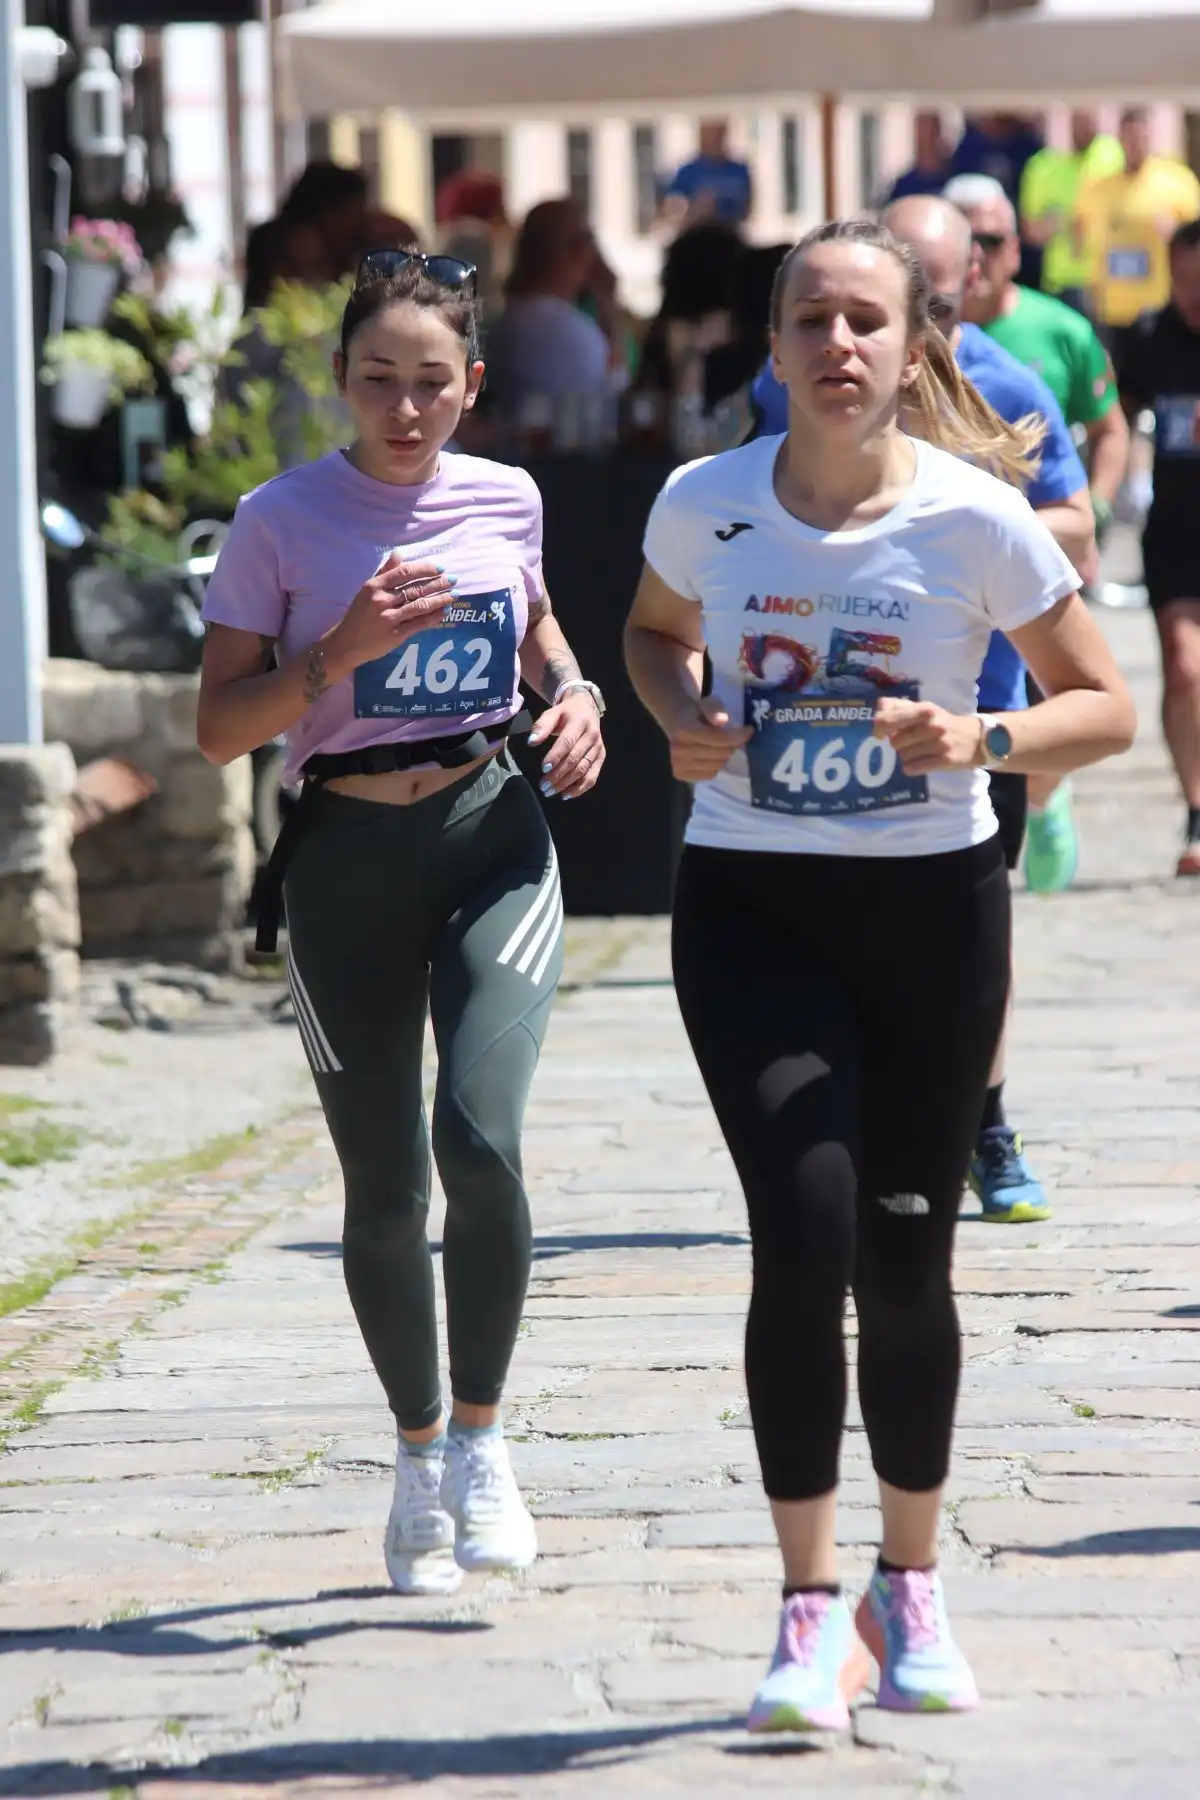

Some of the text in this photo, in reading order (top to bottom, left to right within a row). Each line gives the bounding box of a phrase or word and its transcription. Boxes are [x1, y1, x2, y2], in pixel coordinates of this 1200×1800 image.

[442, 609, 487, 624] NĐELA
[743, 594, 910, 621] AJMO RIJEKA!
[385, 637, 493, 696] 462
[775, 707, 823, 724] GRADA
[772, 736, 897, 793] 460
